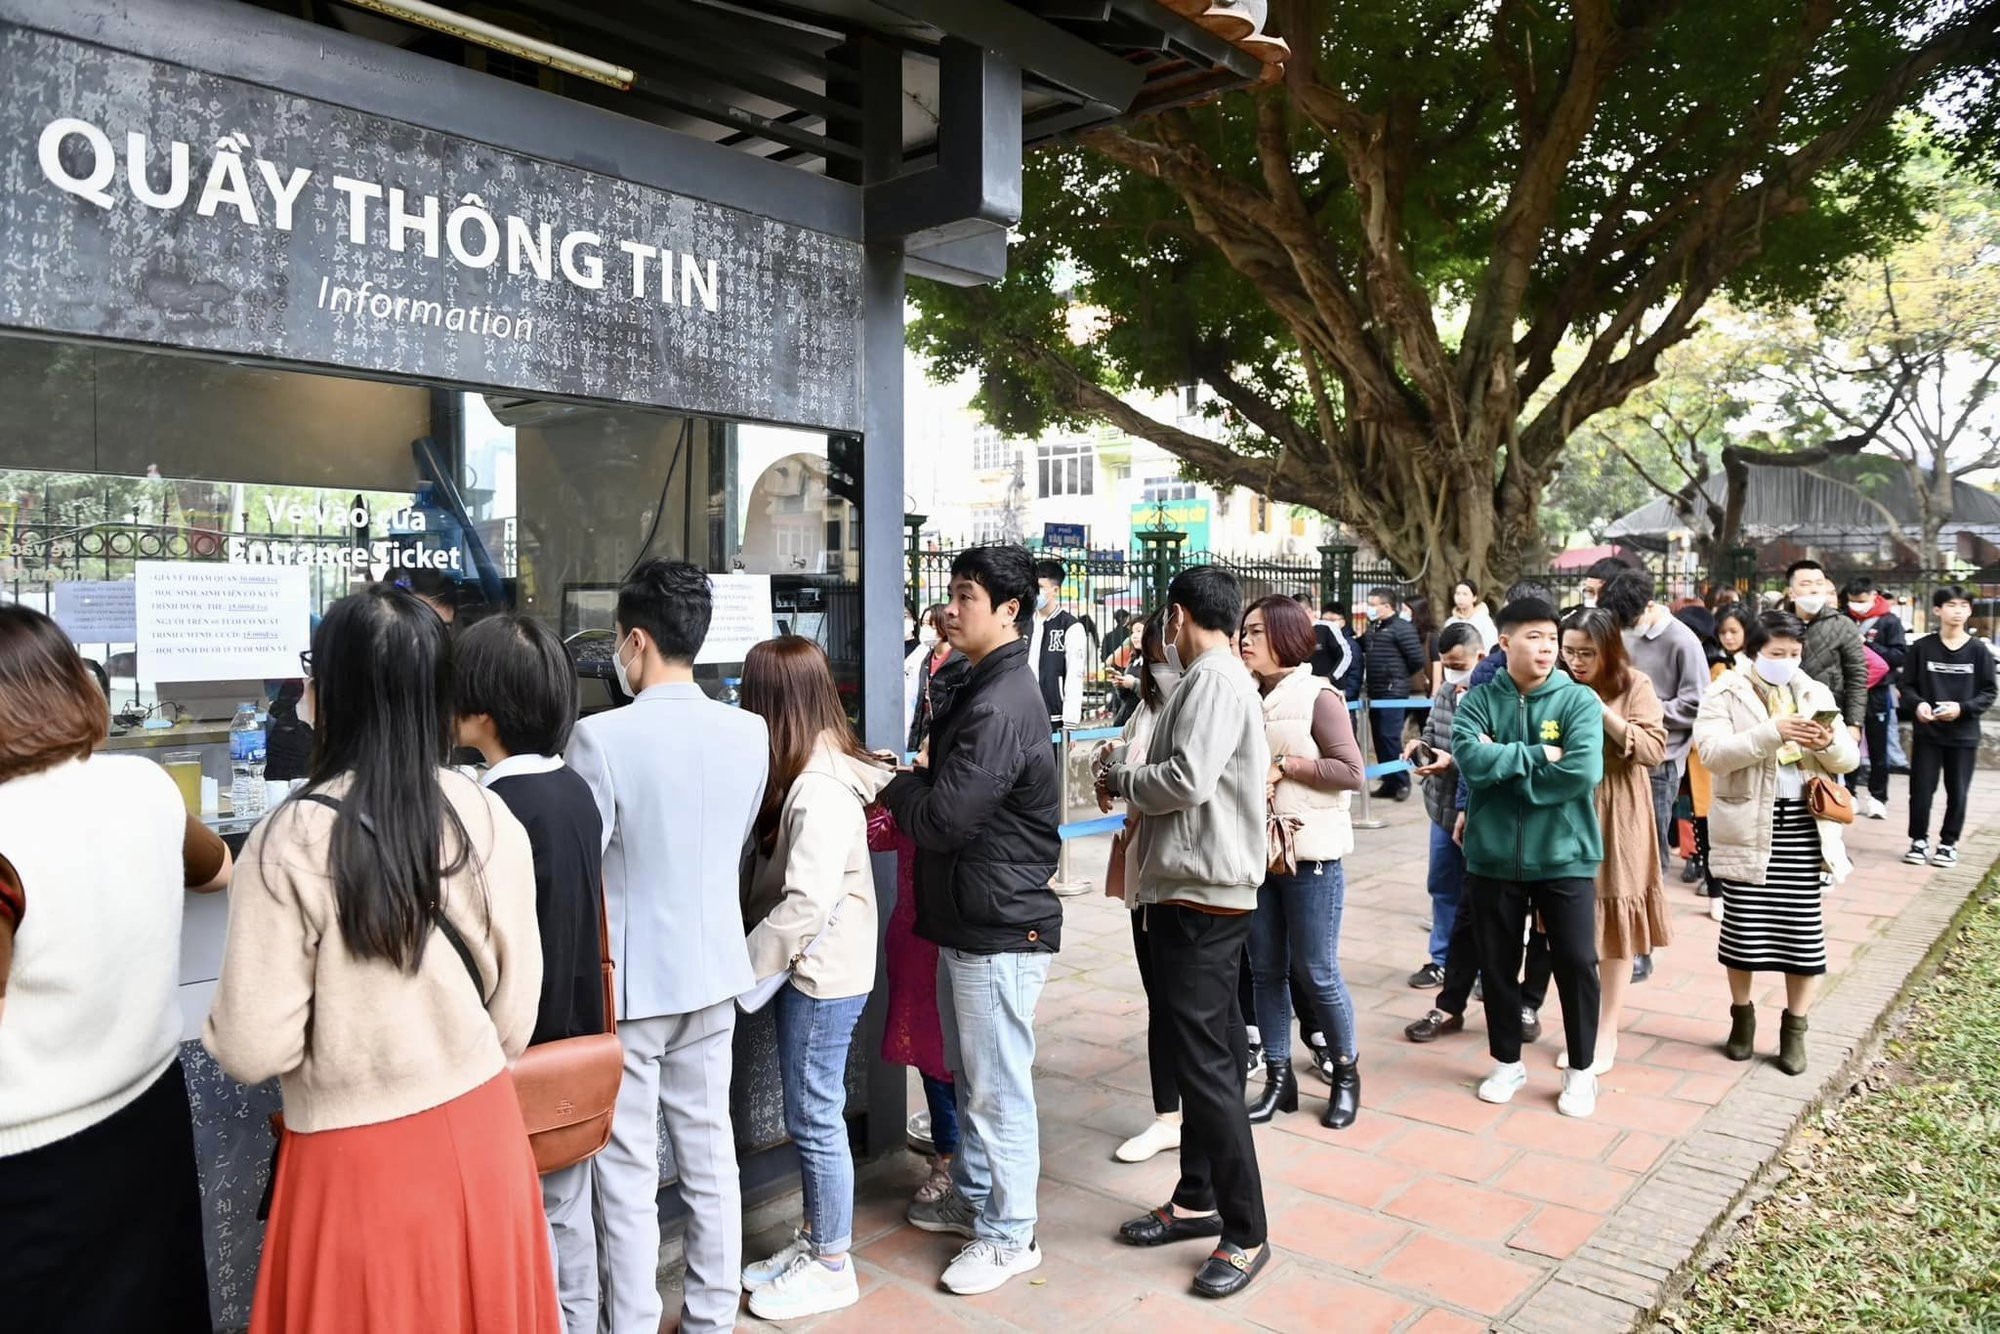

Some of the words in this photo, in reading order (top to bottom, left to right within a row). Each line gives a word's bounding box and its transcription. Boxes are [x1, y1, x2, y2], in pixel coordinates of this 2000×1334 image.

[38, 118, 312, 231] QUẦY
[333, 176, 604, 289] THÔNG
[621, 241, 718, 312] TIN
[318, 276, 533, 342] Information
[229, 537, 368, 567] Entrance
[373, 540, 460, 569] Ticket
[1048, 629, 1065, 652] K
